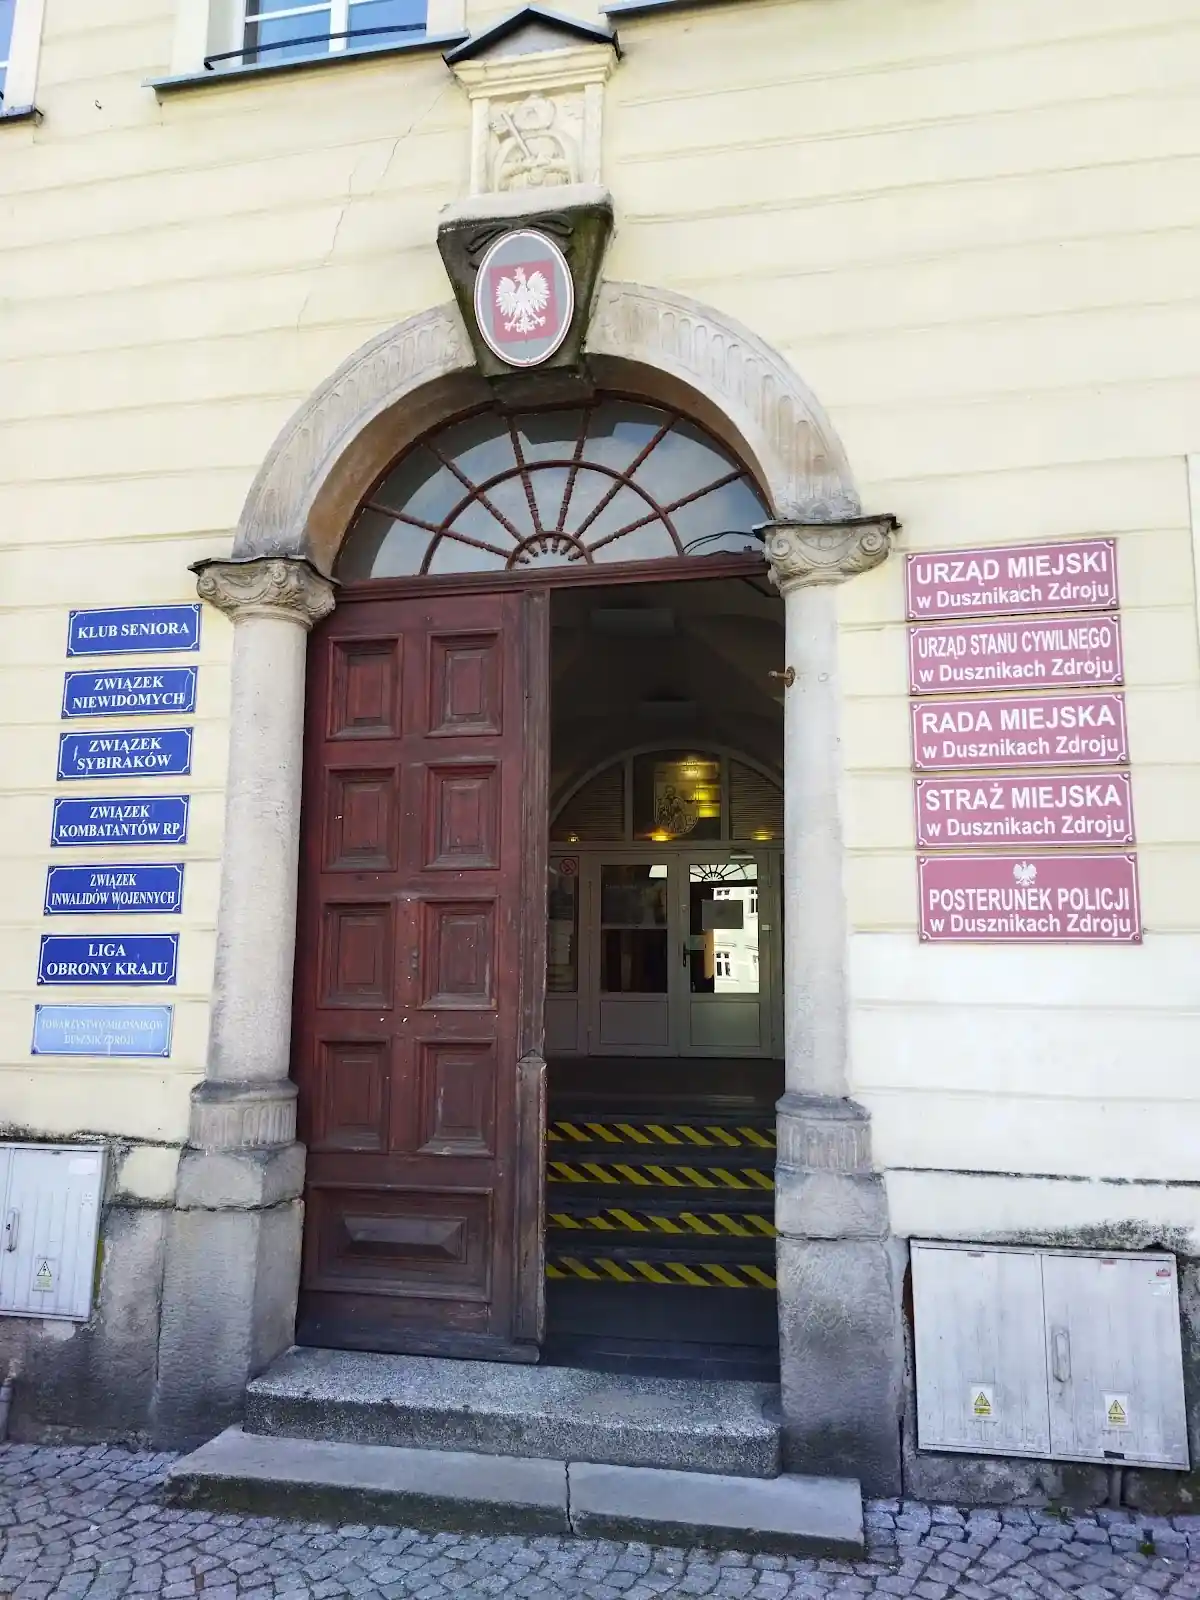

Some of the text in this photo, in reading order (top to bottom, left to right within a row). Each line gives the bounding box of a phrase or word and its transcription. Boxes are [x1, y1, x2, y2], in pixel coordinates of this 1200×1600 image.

[916, 551, 1107, 586] URZĄD MIEJSKI
[916, 581, 1109, 608] w Dusznikach Zdroju
[78, 622, 189, 639] KLUB SENIORA
[918, 627, 1111, 659] URZĄD STANU CYWILNEGO
[919, 657, 1113, 683] w Dusznikach Zdroju
[94, 676, 164, 692] ZWIĄZEK
[73, 693, 184, 708] NIEWIDOMYCH
[922, 704, 1116, 734] RADA MIEJSKA
[89, 738, 162, 754] ZWIĄZEK
[922, 734, 1119, 759] w Dusznikach Zdroju
[77, 751, 172, 770] SYBIRAKÓW
[925, 783, 1122, 811] STRAŻ MIEJSKA
[90, 805, 150, 821] ZWIĄZEK
[59, 820, 180, 837] KOMBATANTÓW RP
[926, 815, 1125, 838] w Dusznikach Zdroju
[90, 873, 137, 889] ZWIĄZEK
[51, 889, 175, 905] INWALIDÓW WOJENNYCH
[929, 887, 1130, 911] POSTERUNEK POLICJI
[930, 913, 1131, 937] w Dusznikach Zdroju
[88, 944, 126, 957] LIGA
[46, 962, 168, 976] OBRONY KRAJU
